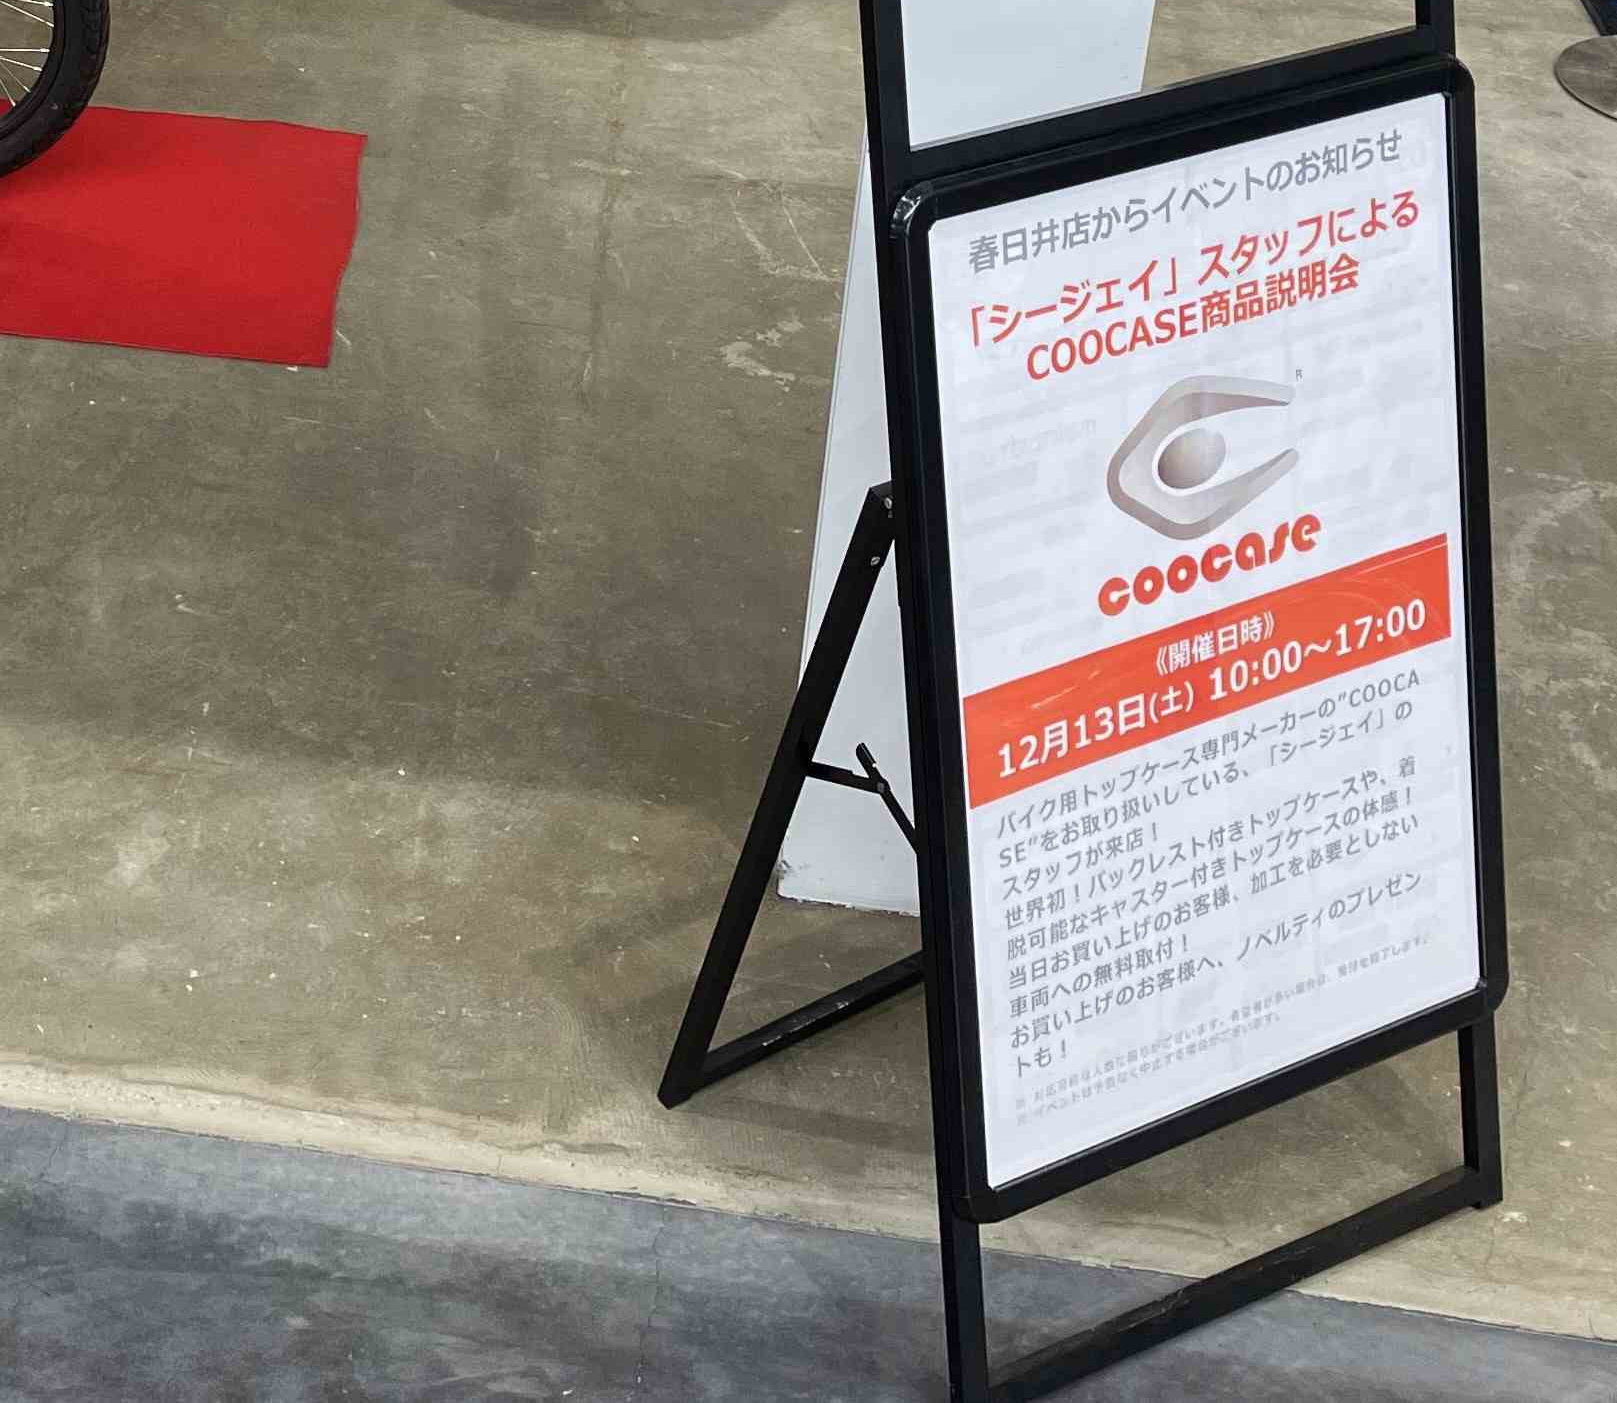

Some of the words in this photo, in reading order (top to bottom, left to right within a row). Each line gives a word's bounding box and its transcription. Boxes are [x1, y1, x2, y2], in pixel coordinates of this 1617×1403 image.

[967, 128, 1403, 275] 春日井店からイベントのお知らせ
[1026, 253, 1361, 381] COOCASE商品説明会
[1097, 512, 1322, 617] coocase
[997, 680, 1196, 779] 12月13日(土)
